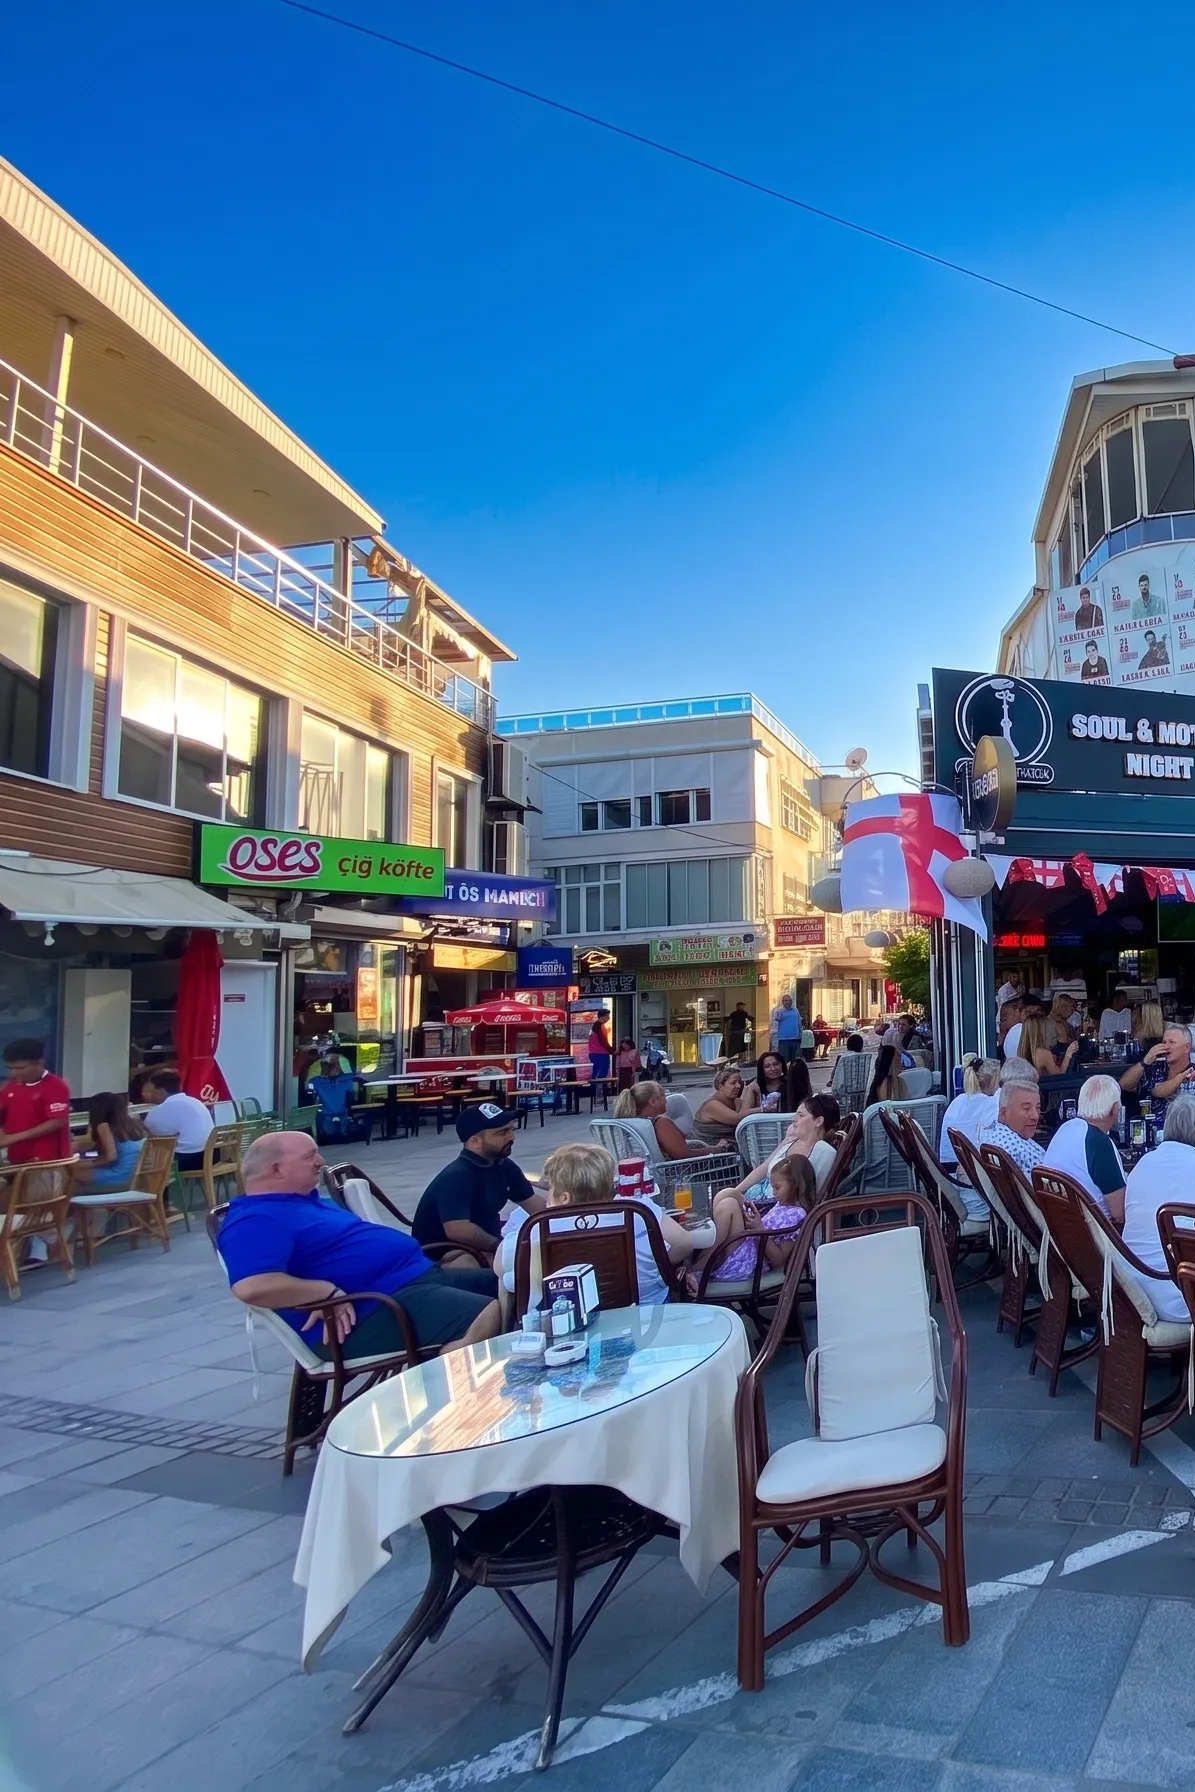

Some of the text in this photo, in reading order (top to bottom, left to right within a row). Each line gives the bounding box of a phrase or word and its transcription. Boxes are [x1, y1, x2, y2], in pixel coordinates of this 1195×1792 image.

[1072, 713, 1133, 741] SOUL
[1136, 718, 1153, 743] &
[1127, 753, 1194, 779] NIGHT
[379, 857, 435, 880] köfte
